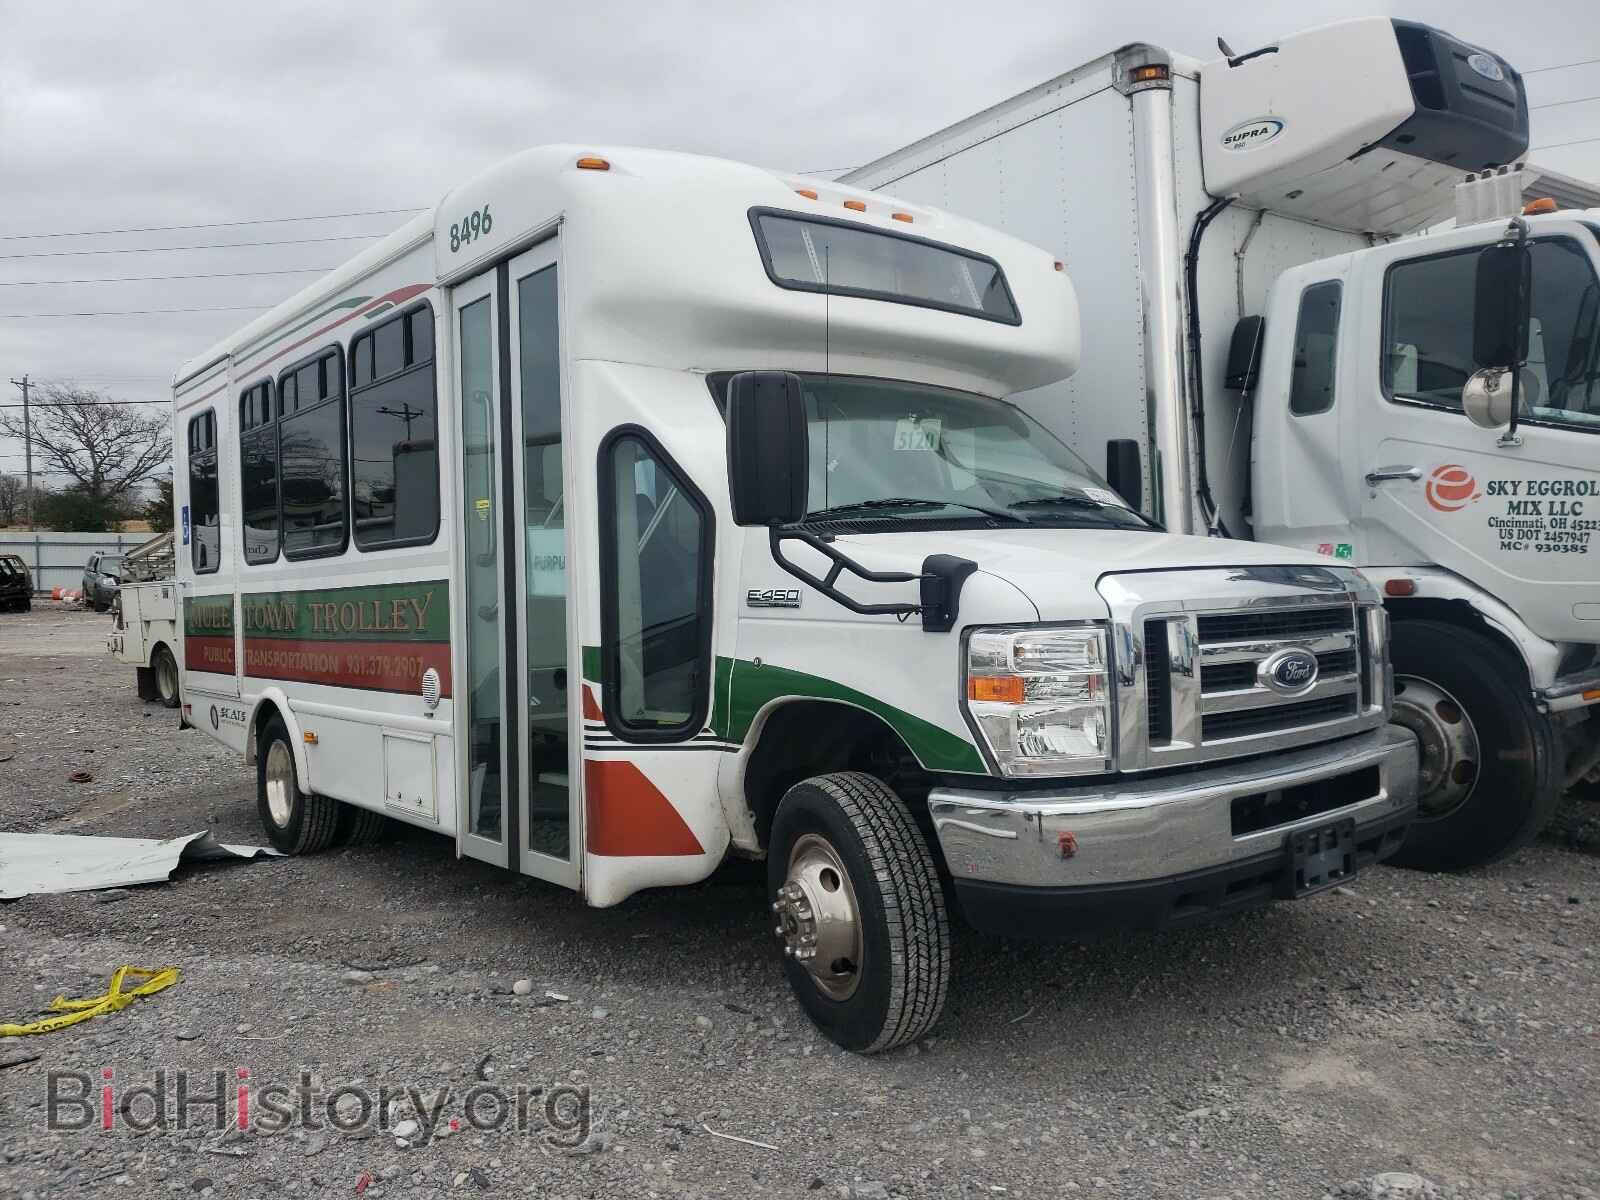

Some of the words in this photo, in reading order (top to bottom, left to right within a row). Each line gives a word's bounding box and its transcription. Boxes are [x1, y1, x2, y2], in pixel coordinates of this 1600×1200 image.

[1224, 128, 1269, 144] SUPRA
[450, 204, 492, 252] 8496
[1487, 480, 1521, 496] SKY
[1507, 500, 1542, 516] MIX
[1548, 500, 1583, 516] LLC
[1488, 516, 1546, 530] Cincinnati,
[1550, 518, 1567, 529] OH
[1499, 529, 1514, 540] US
[1517, 530, 1541, 540] DOT
[1543, 531, 1590, 543] 2457947
[1535, 544, 1588, 553] 930385
[747, 589, 800, 601] E-450
[242, 600, 297, 629] TOWN
[309, 592, 433, 633] TROLLEY
[203, 646, 233, 664] PUBLIC
[244, 648, 338, 673] TRANSPORTATION
[1285, 661, 1311, 680] Ford
